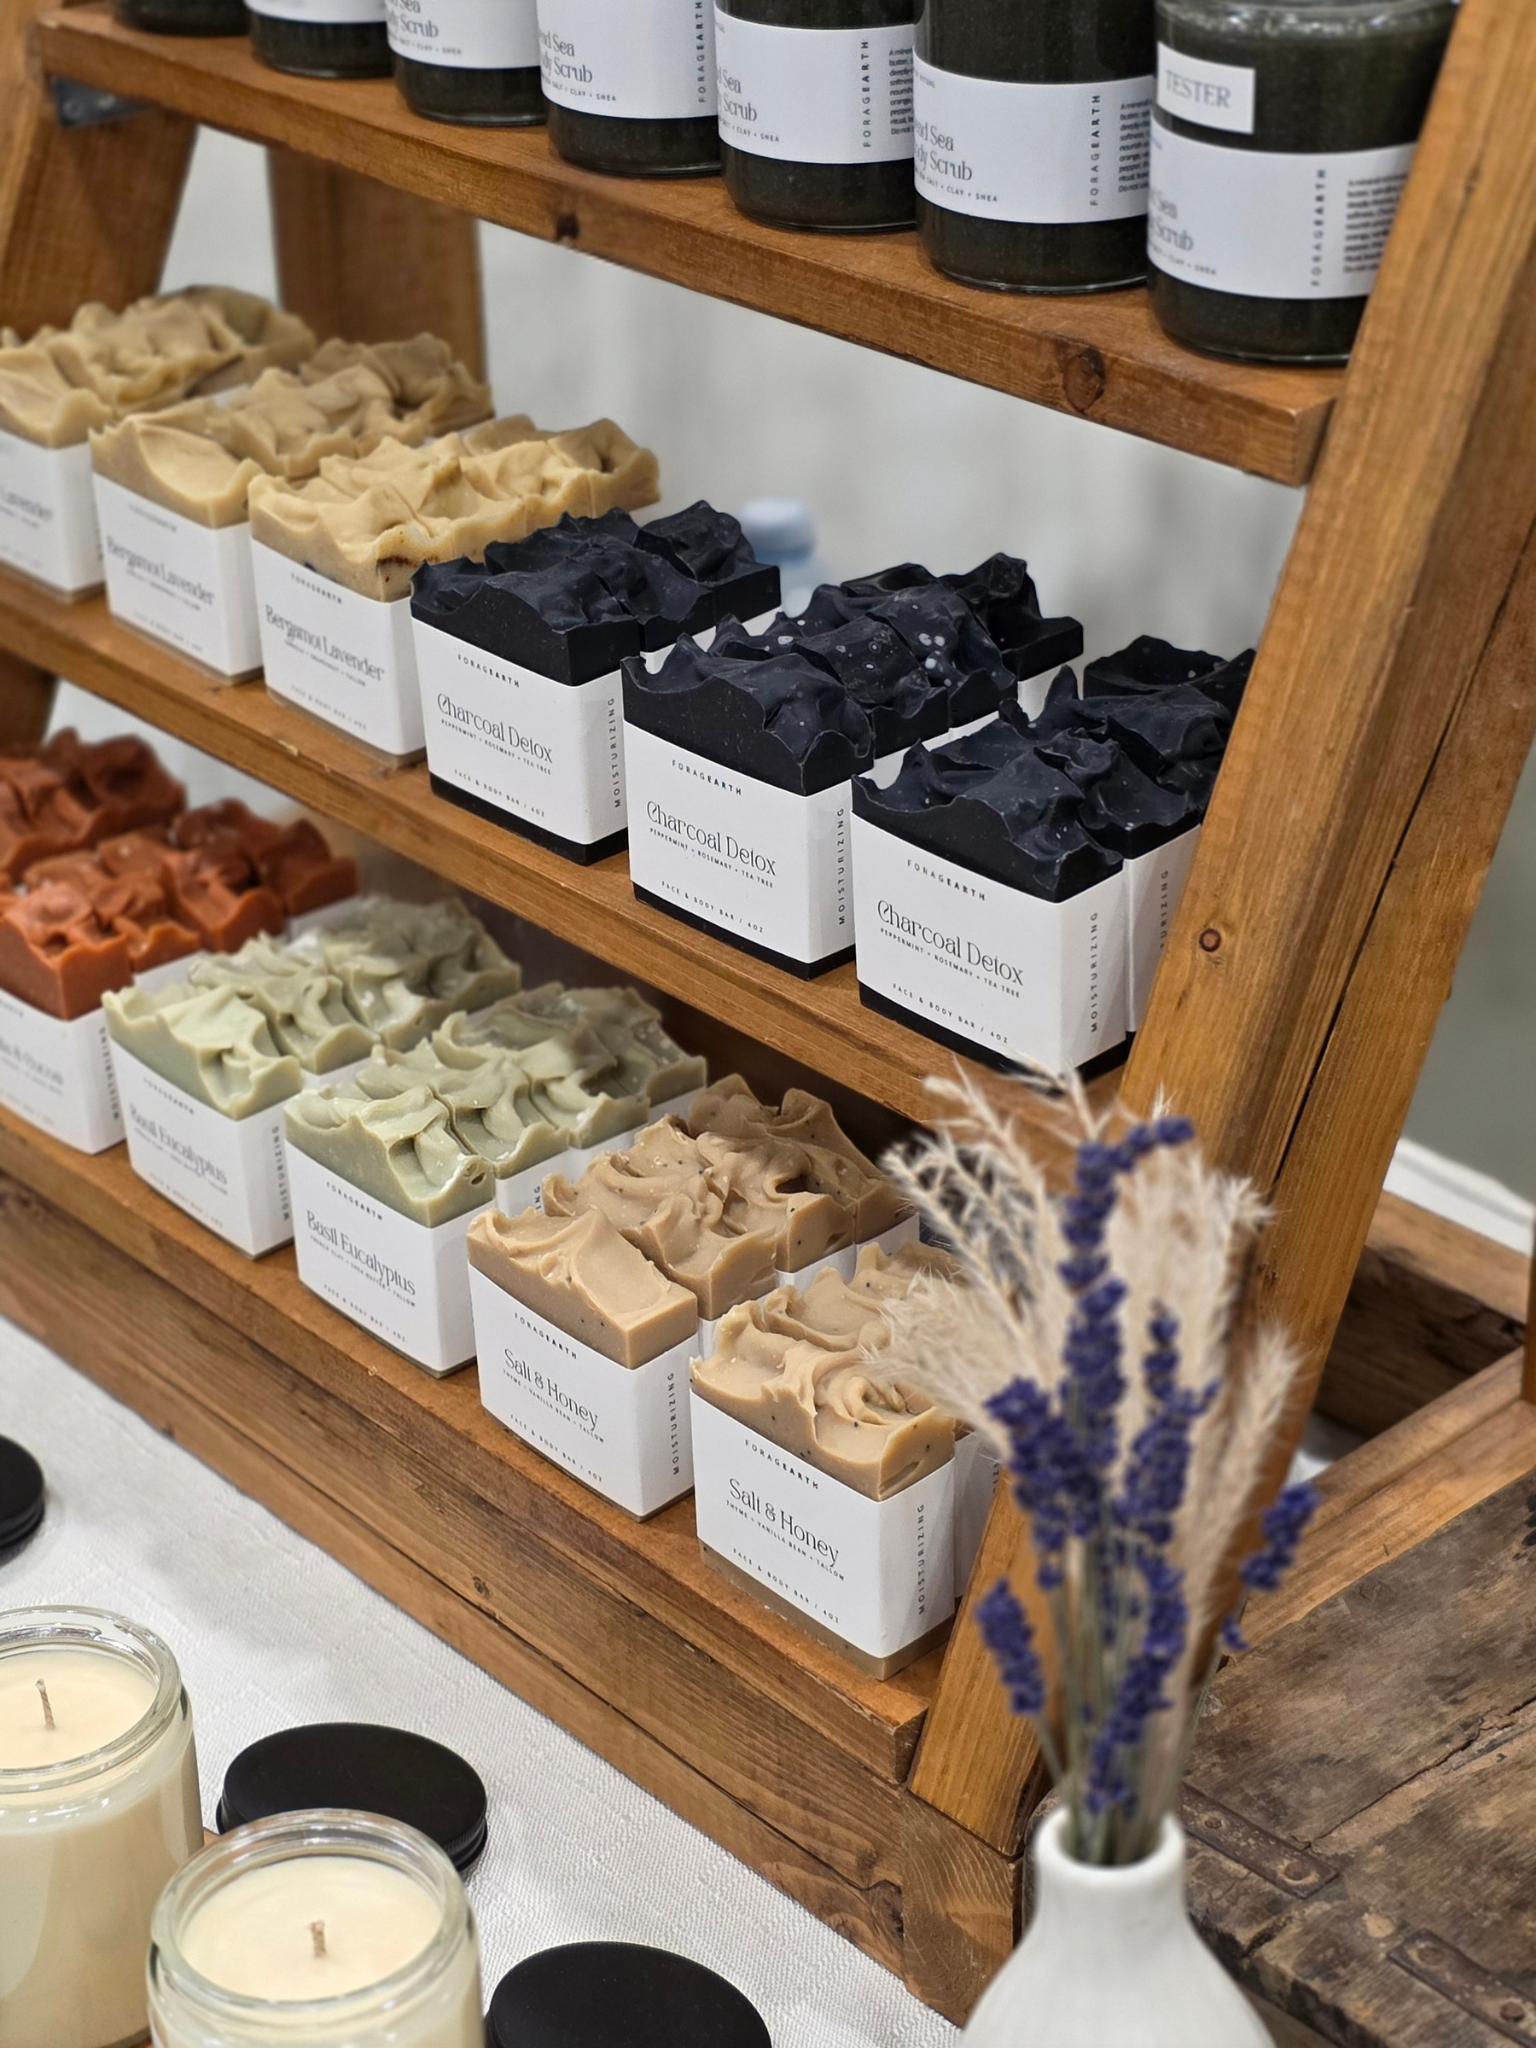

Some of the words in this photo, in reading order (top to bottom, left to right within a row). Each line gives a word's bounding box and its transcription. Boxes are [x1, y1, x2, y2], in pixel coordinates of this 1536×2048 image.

[552, 33, 575, 57] Sea
[554, 56, 593, 83] Scrub
[695, 2, 706, 103] FORAGEARTH
[722, 69, 742, 94] Sea
[723, 93, 758, 122] Scrub
[861, 41, 871, 147] FORAGEARTH
[1165, 69, 1231, 109] TESTER
[930, 125, 954, 151] Sea
[930, 150, 973, 181] Scrub
[1089, 94, 1101, 206] FORAGEARTH
[946, 185, 964, 196] CLAY
[975, 192, 998, 202] SHEA
[265, 604, 322, 652] Bergamot
[322, 635, 385, 681] Lavender
[458, 653, 520, 688] FORAGEARTH
[437, 693, 505, 742] Charcoal
[508, 725, 553, 764] Detox
[607, 698, 621, 808] MOISTURIZING
[672, 759, 742, 796] FORAGEARTH
[647, 800, 722, 853] Charcoal
[726, 835, 776, 876] Detox
[650, 827, 688, 850] PEPPERMINT
[697, 850, 732, 870] ROSEMARY
[741, 870, 754, 880] TEA
[756, 876, 773, 889] TREE
[836, 808, 846, 925] MOISTURIZING
[661, 880, 680, 895] FACE
[693, 896, 714, 911] BODY
[719, 908, 735, 921] BAR
[747, 921, 764, 934] 4OZ
[907, 859, 986, 901] FORAGEARTH
[877, 899, 962, 959] Charcoal
[967, 941, 1024, 986] Detox
[880, 927, 923, 953] PEPPERMINT
[934, 954, 973, 977] ROSEMARY
[983, 977, 998, 989] TEA
[1000, 985, 1020, 998] TREE
[1090, 912, 1098, 1033] MOISTURIZING
[892, 983, 913, 998] FACE
[929, 1001, 953, 1018] BODY
[957, 1015, 976, 1029] BAR
[990, 1030, 1008, 1044] 4OZ
[326, 1181, 383, 1221] FORAGEARTH
[306, 1209, 338, 1246] Basil
[340, 1231, 416, 1296] Eucalyptus
[515, 1312, 577, 1360] FORAGEARTH
[504, 1348, 531, 1382] Salt
[534, 1371, 544, 1390] &
[547, 1377, 598, 1432] Honey
[667, 1373, 680, 1476] MOISTURIZING
[745, 1439, 819, 1490] FORAGEARTH
[726, 1499, 748, 1519] THYME
[757, 1521, 786, 1543] VANILLA
[788, 1541, 807, 1557] BEAN
[816, 1558, 845, 1581] TALLOW
[729, 1478, 761, 1515] Salt
[765, 1502, 776, 1522] &
[780, 1508, 839, 1568] Honey
[917, 1504, 926, 1615] MOISTURIZING
